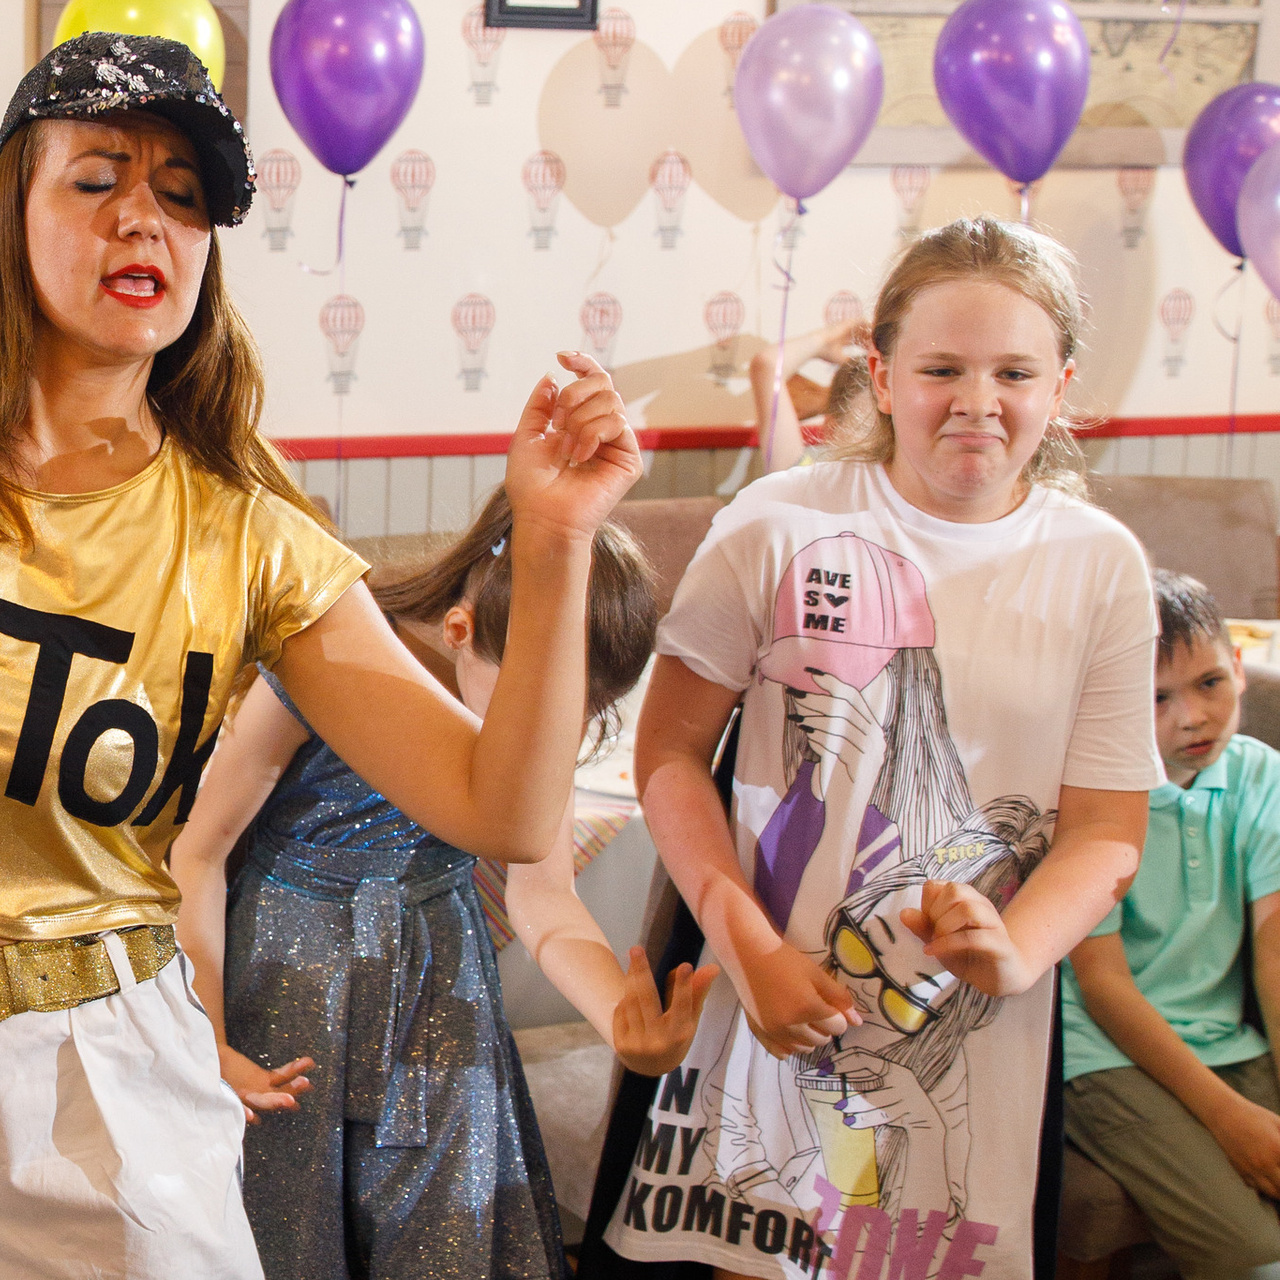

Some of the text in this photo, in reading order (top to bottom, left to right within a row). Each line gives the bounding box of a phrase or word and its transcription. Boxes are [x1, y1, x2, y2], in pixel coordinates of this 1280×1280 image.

[805, 568, 851, 589] AVE
[803, 613, 846, 634] ME
[934, 842, 985, 865] TRICK
[657, 1066, 700, 1115] N
[635, 1120, 708, 1175] MY
